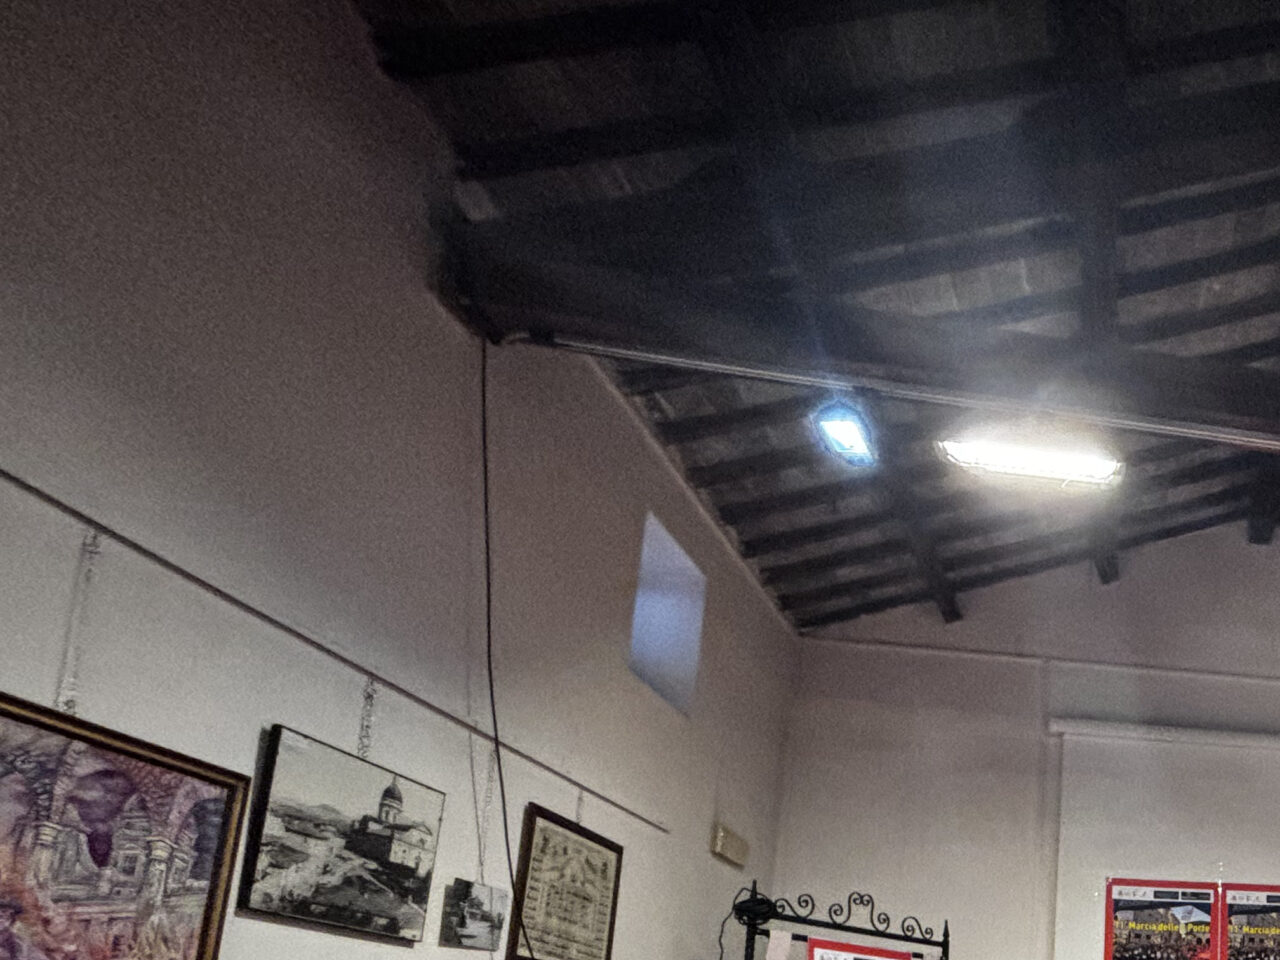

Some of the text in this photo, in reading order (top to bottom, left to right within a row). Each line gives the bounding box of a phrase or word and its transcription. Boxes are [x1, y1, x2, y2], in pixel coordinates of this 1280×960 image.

[1128, 922, 1157, 931] Marcia
[1187, 923, 1211, 932] Porte
[1242, 926, 1270, 934] Marcia
